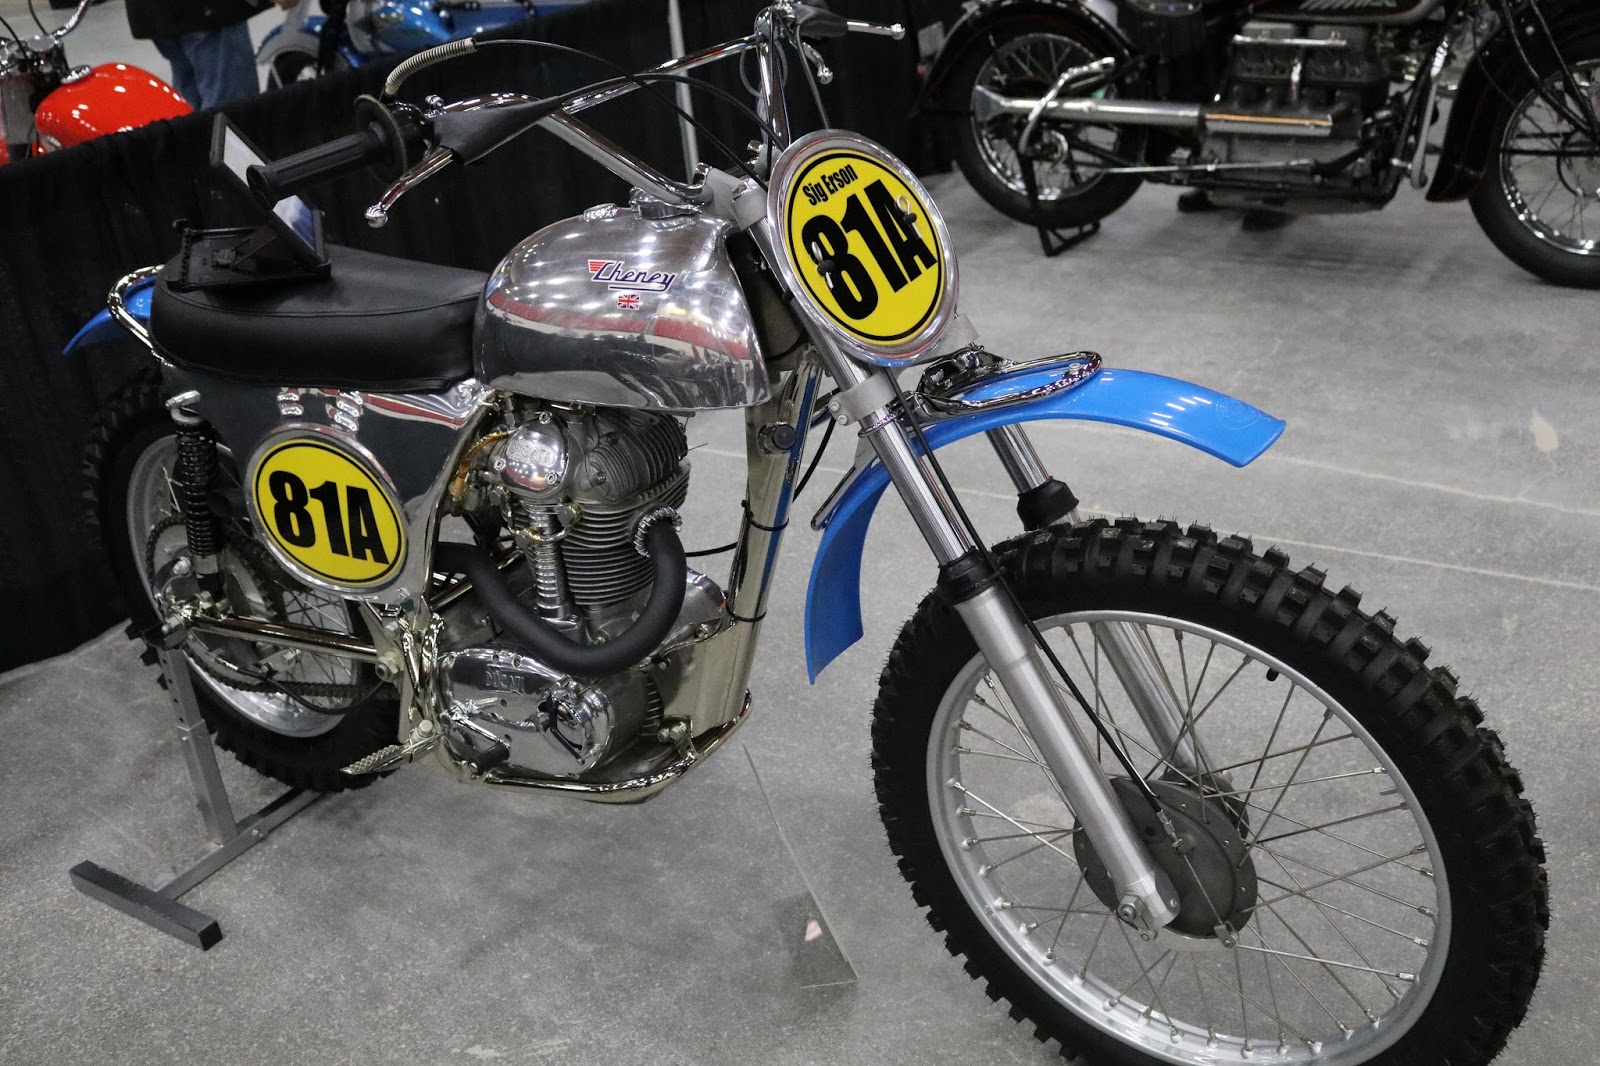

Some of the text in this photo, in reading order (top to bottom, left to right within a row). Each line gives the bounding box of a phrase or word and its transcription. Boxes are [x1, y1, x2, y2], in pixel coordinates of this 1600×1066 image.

[802, 164, 859, 206] Sig Erson
[801, 178, 938, 320] 81A
[591, 261, 677, 292] Cheney
[268, 470, 390, 565] 81A
[485, 669, 525, 693] DUCATI
